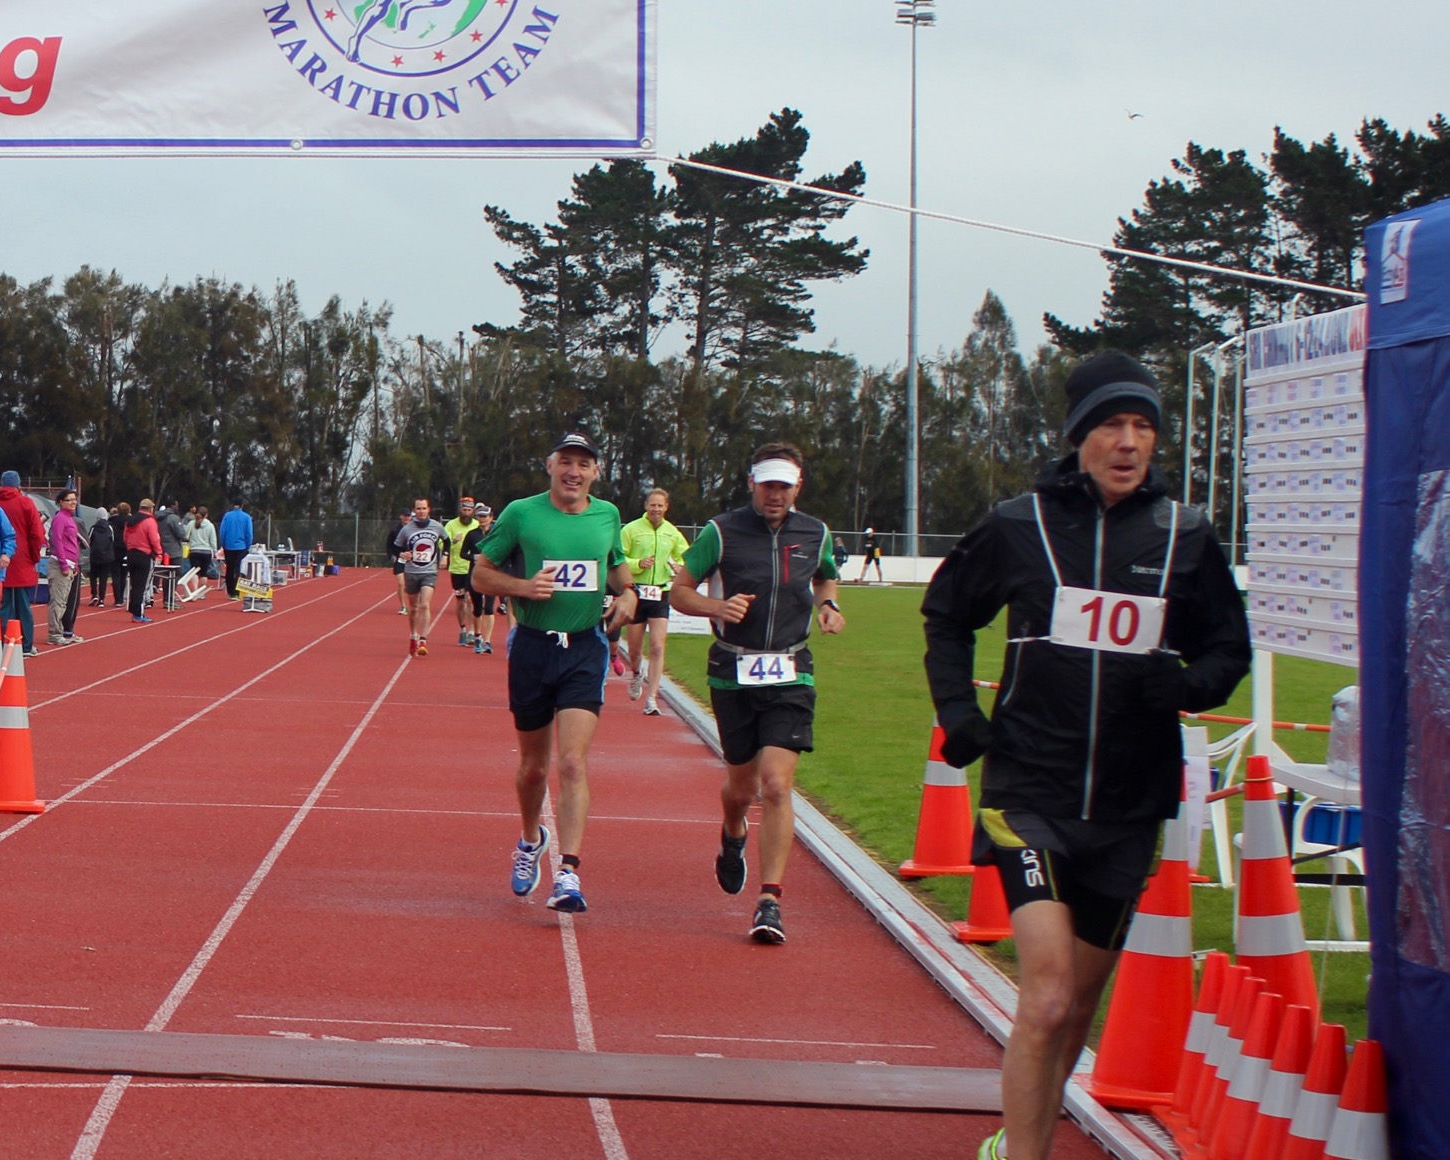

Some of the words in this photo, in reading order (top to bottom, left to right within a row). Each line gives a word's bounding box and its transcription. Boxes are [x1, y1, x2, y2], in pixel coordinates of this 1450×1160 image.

[263, 1, 461, 121] MARATHON
[468, 4, 559, 101] TEAM
[416, 552, 429, 561] 22
[554, 563, 587, 588] 42
[642, 586, 657, 599] 14
[1080, 596, 1140, 647] 10
[748, 656, 785, 680] 44
